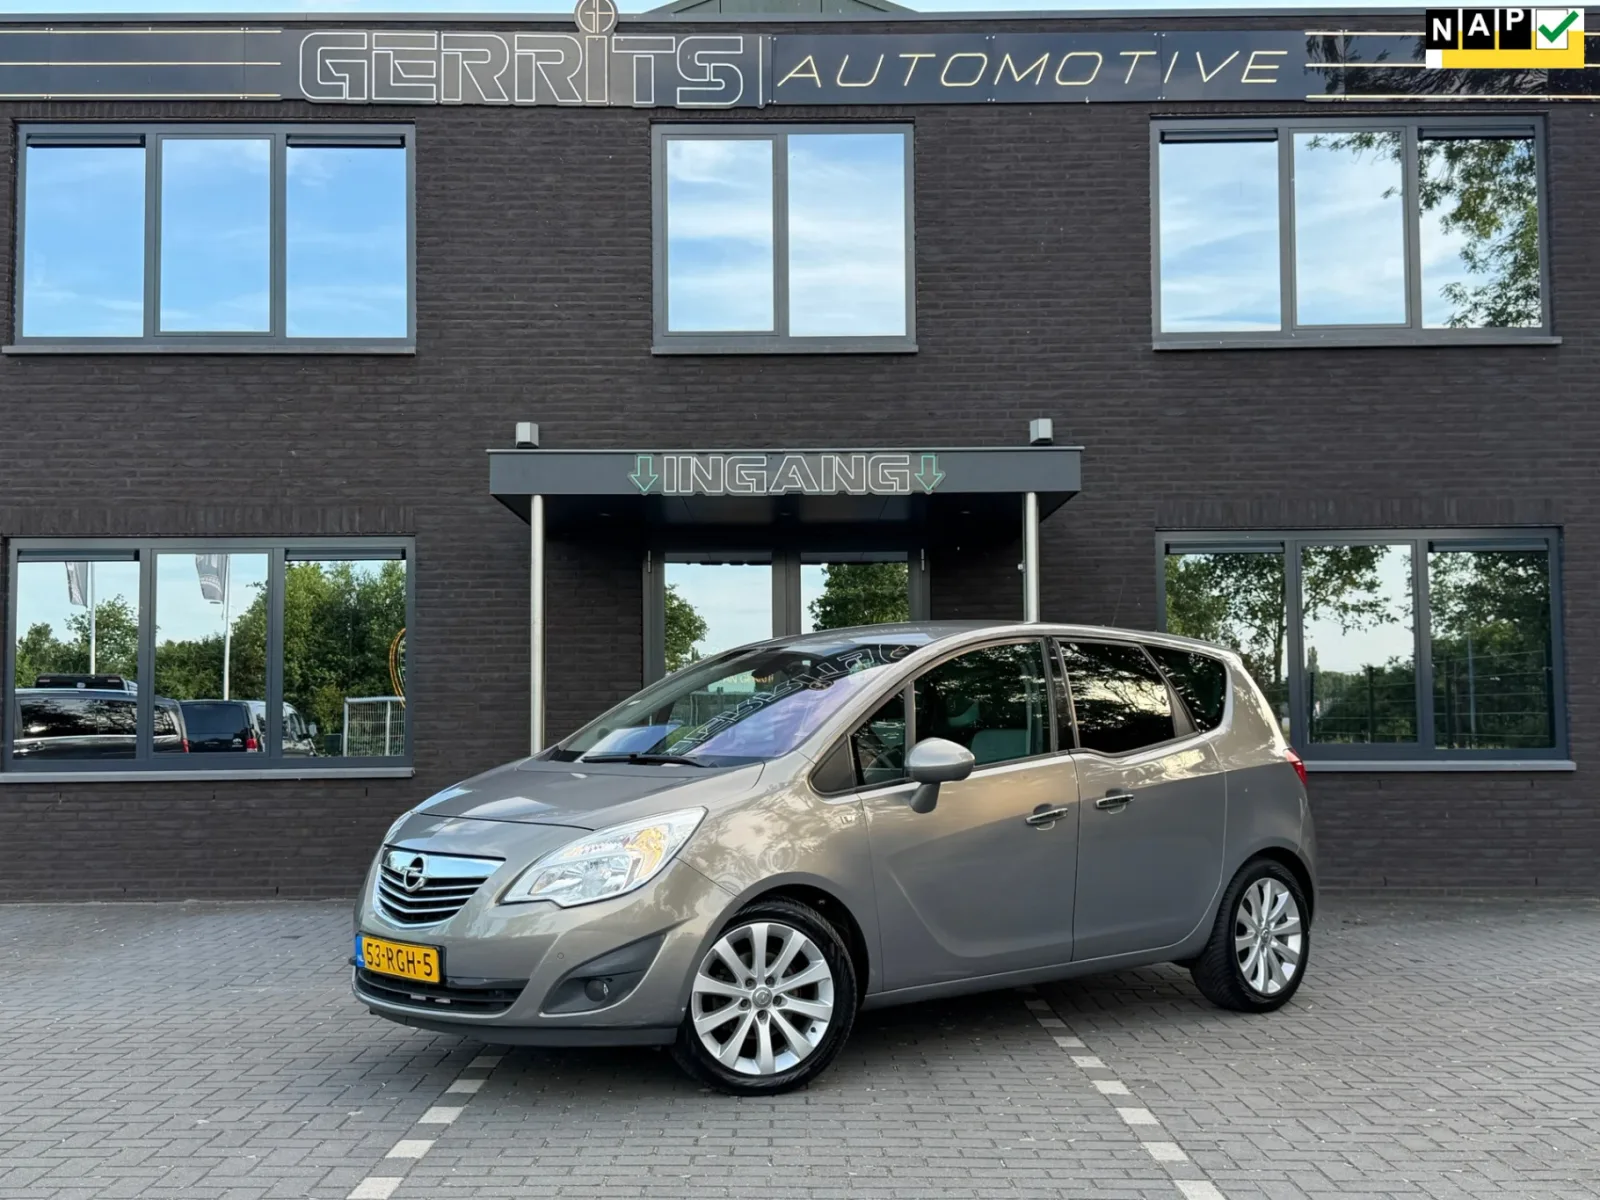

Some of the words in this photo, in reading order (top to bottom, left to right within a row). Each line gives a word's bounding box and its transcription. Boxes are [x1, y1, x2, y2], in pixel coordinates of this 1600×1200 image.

[299, 32, 744, 106] GERRITS
[777, 50, 1288, 88] AUTOMOTIVE
[663, 455, 910, 493] INGANG
[366, 943, 433, 977] 53-RGH-5
